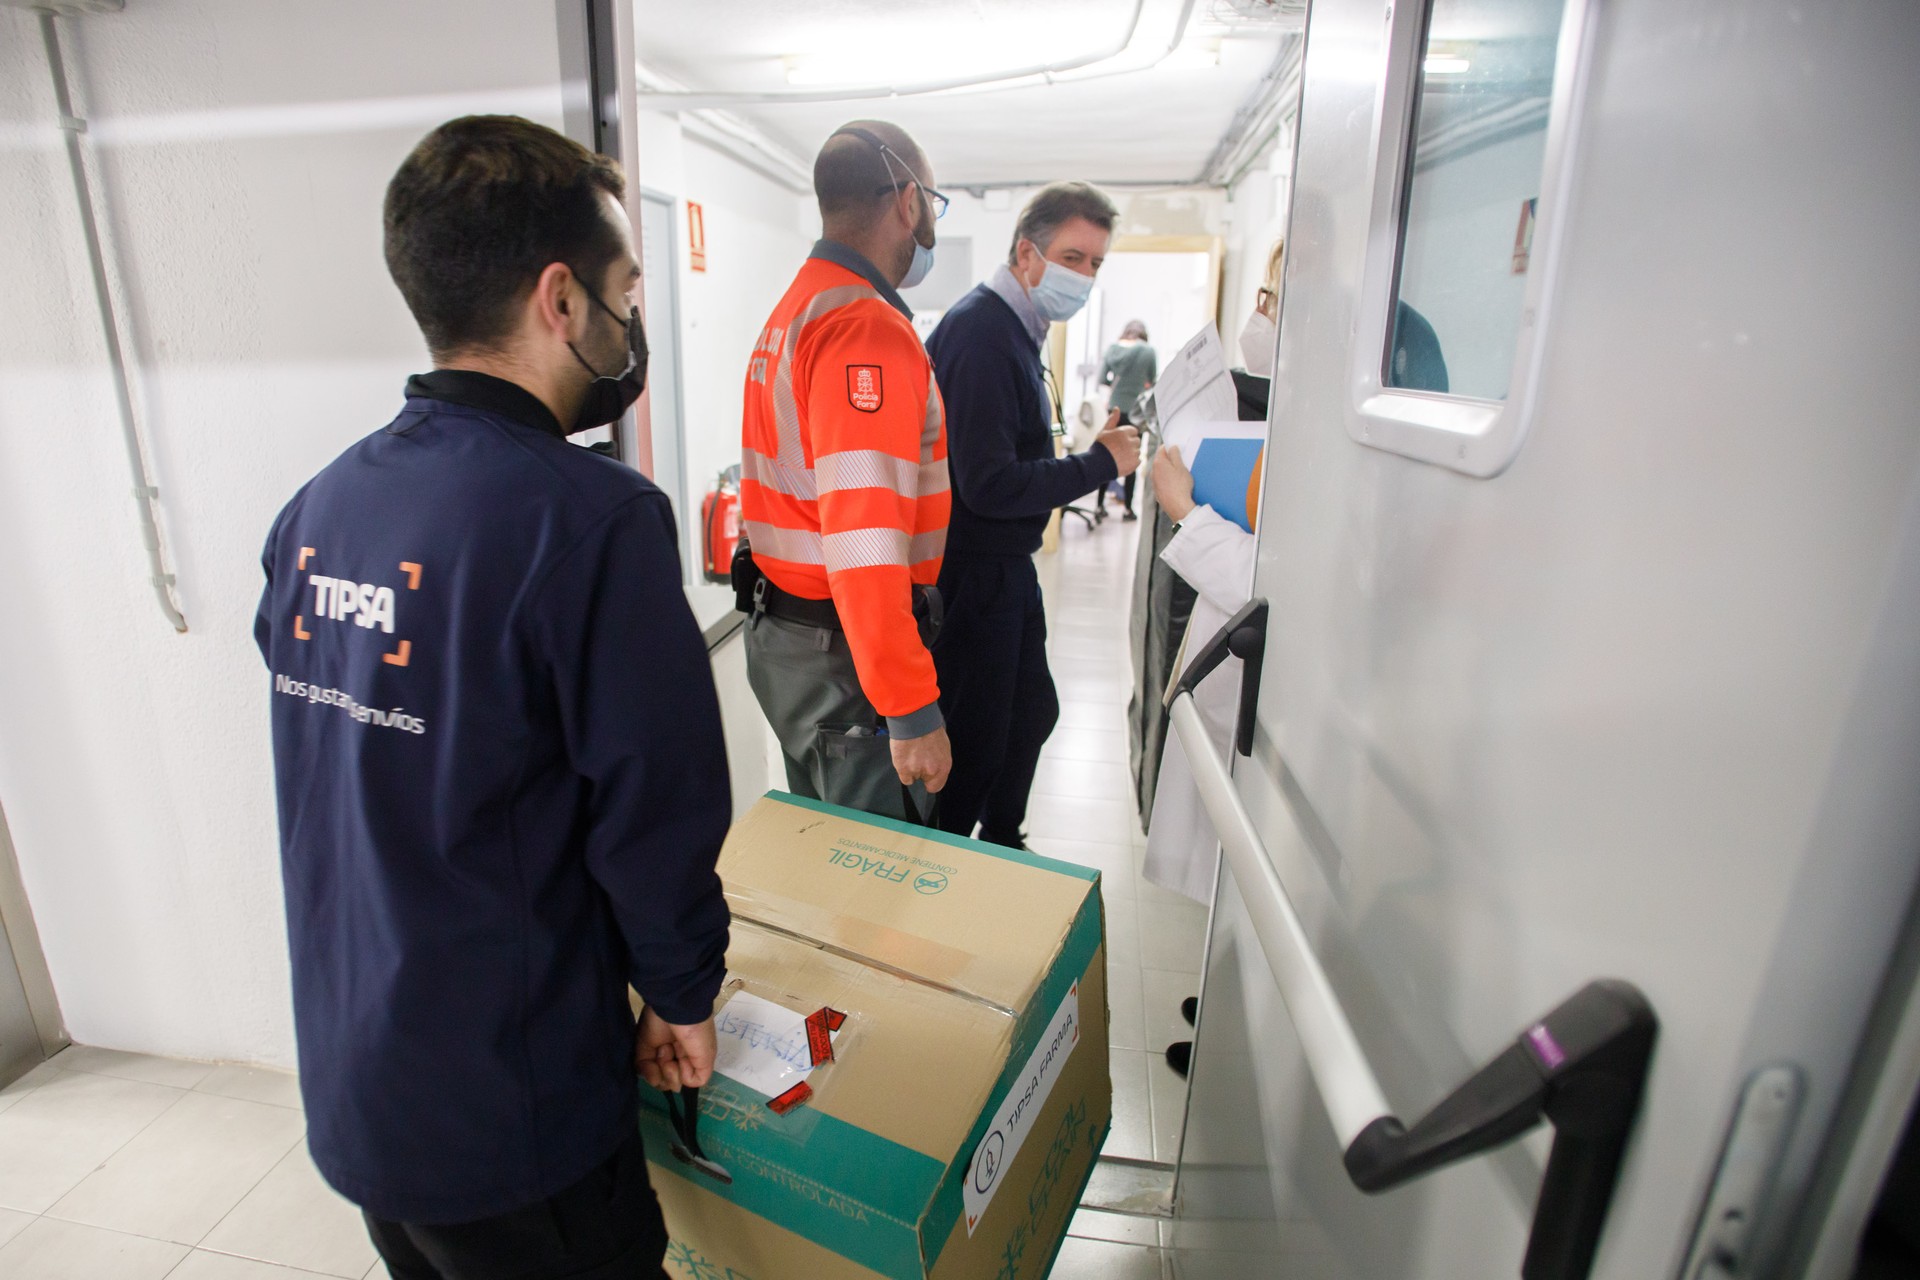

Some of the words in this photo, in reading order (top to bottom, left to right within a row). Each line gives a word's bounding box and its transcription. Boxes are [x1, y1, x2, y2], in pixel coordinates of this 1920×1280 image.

[309, 575, 395, 634] TIPSA
[276, 674, 307, 696] Nos
[829, 848, 910, 883] FRÁGIL
[837, 838, 909, 862] MEDICAMENTOS
[911, 856, 957, 875] CONTIENE
[1007, 1076, 1038, 1132] TIPSA
[1040, 1014, 1072, 1078] FARMA
[738, 1154, 869, 1225] CONTROLADA
